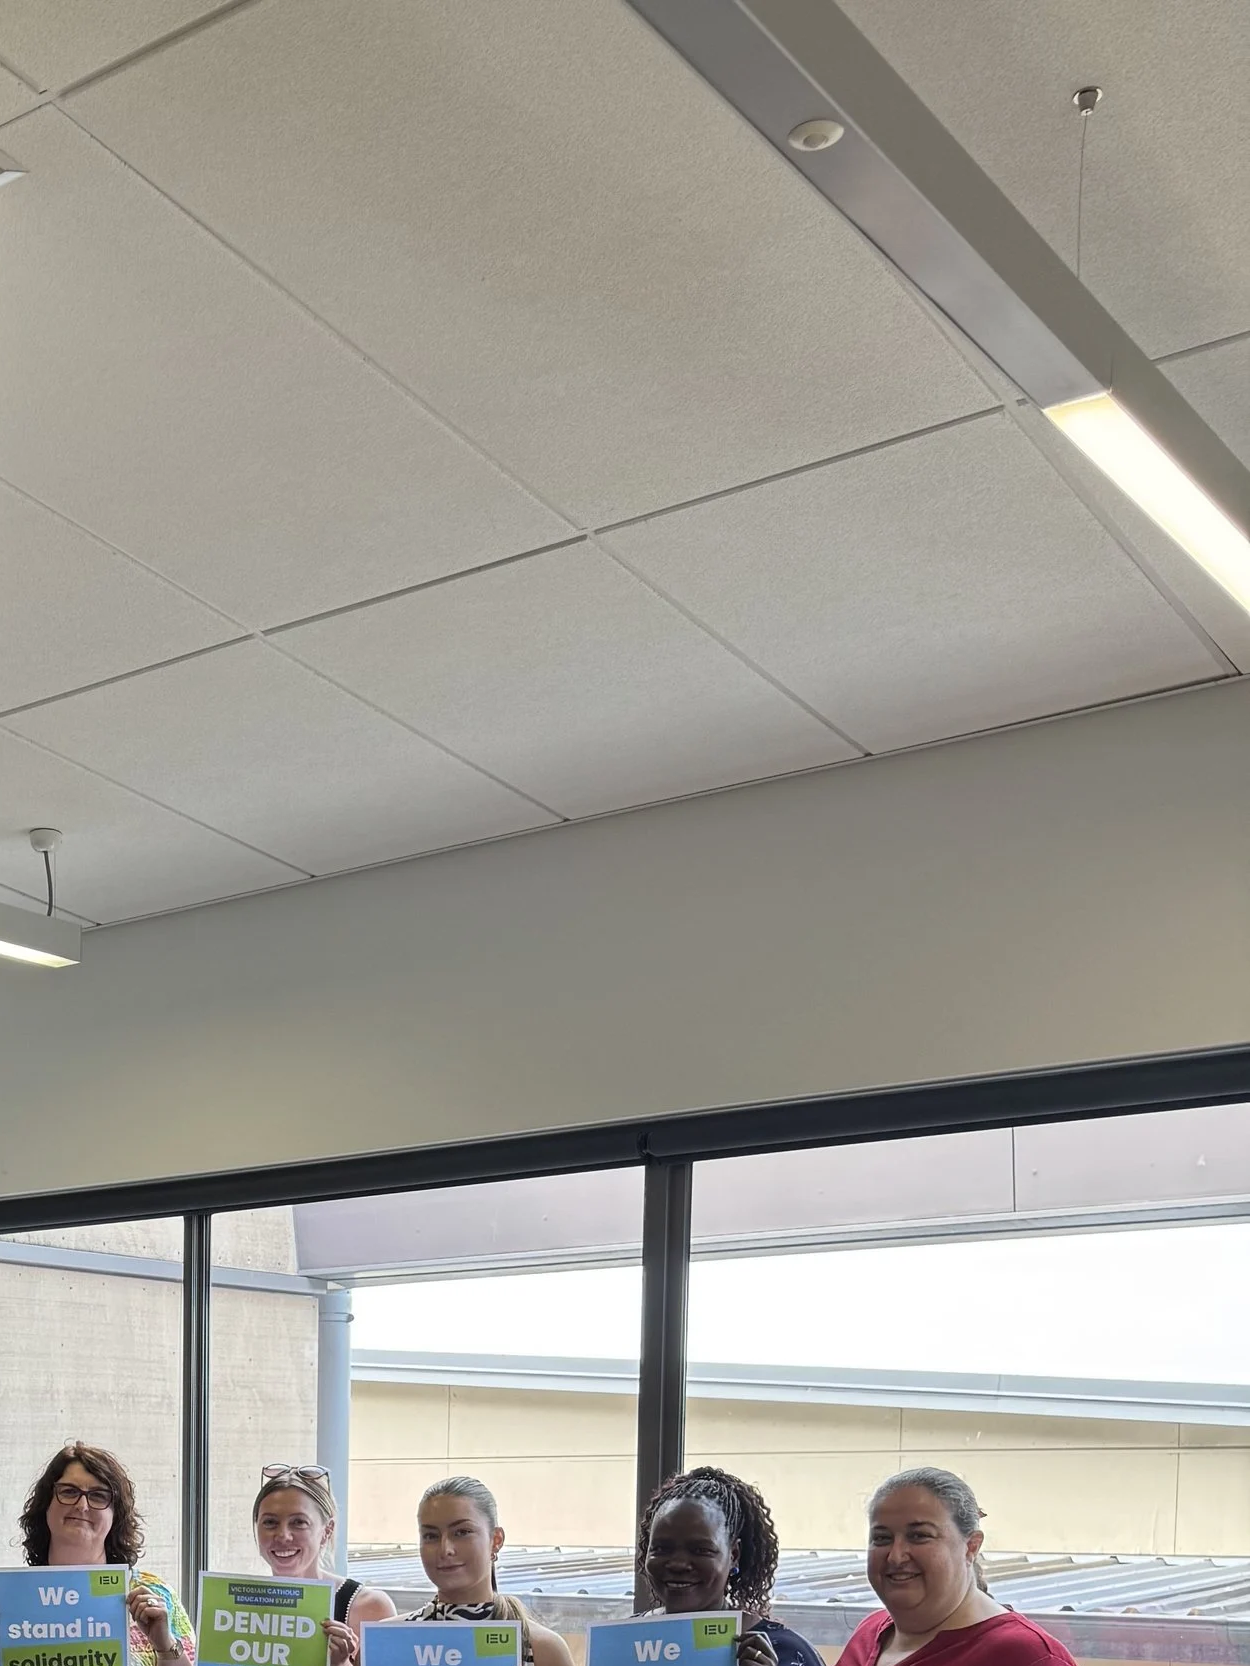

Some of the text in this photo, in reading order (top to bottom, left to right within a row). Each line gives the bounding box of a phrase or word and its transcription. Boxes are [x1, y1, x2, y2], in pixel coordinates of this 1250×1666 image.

[100, 1576, 118, 1584] IEU
[38, 1587, 79, 1606] We
[231, 1586, 300, 1596] VICTORIAN CATHOLIC
[237, 1596, 274, 1604] EDUCATION
[8, 1617, 110, 1638] stand in
[214, 1610, 315, 1638] DENIED
[705, 1624, 727, 1635] IEU
[486, 1634, 509, 1644] IEU
[230, 1640, 290, 1666] OUR
[414, 1645, 462, 1666] We
[635, 1640, 680, 1662] We
